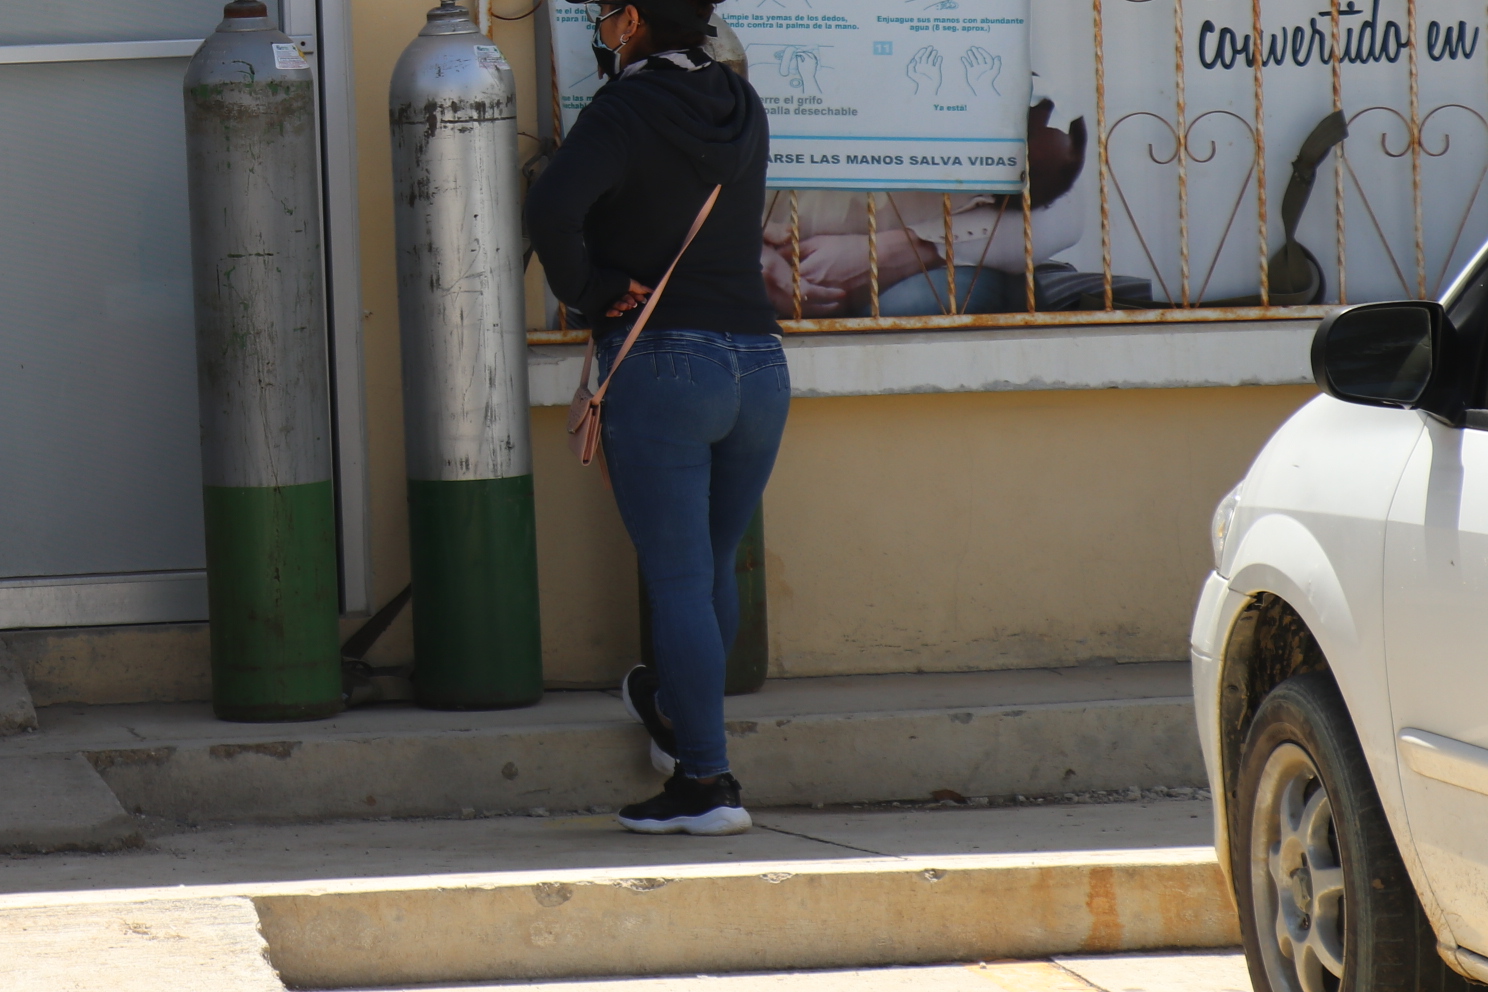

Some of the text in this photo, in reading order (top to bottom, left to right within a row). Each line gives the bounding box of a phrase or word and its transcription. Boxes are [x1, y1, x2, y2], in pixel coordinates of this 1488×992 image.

[877, 16, 914, 24] Enjuague
[980, 17, 1024, 25] abundante
[932, 24, 940, 32] (8
[942, 25, 959, 33] seg.
[962, 25, 991, 33] aprox.)
[1427, 20, 1480, 62] en
[876, 44, 891, 53] 11
[810, 154, 840, 164] LAS
[846, 155, 903, 165] MANOS
[909, 156, 963, 166] SALVA
[968, 156, 1017, 167] VIDAS
